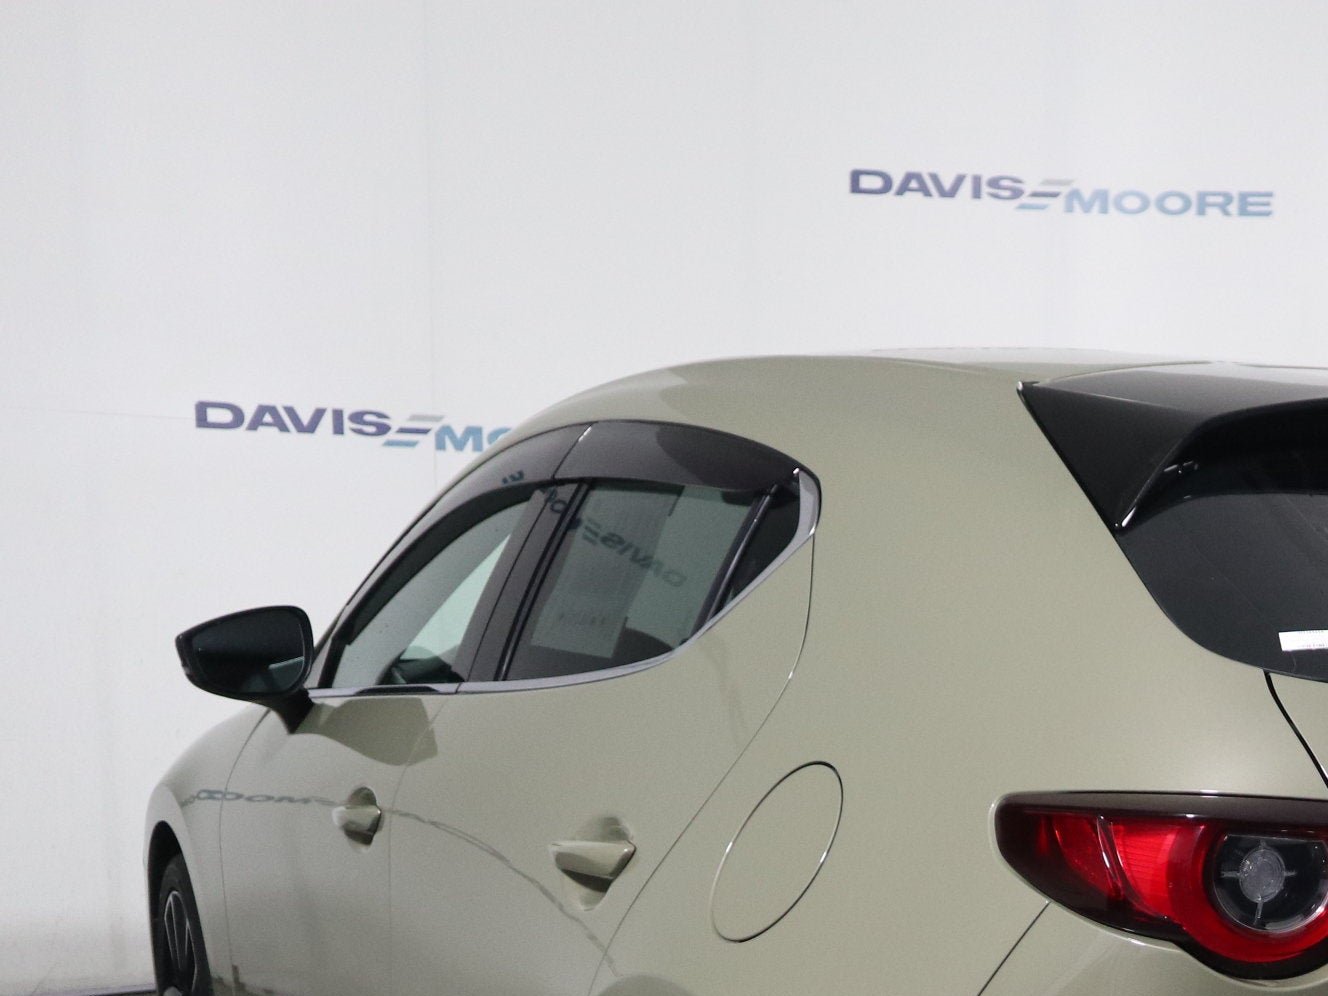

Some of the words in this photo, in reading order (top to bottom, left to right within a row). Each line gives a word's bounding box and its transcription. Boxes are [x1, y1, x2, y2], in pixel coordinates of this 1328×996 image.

[849, 168, 1025, 200] DAVIS
[1063, 188, 1275, 217] MOORE
[195, 401, 391, 436] DAVIS
